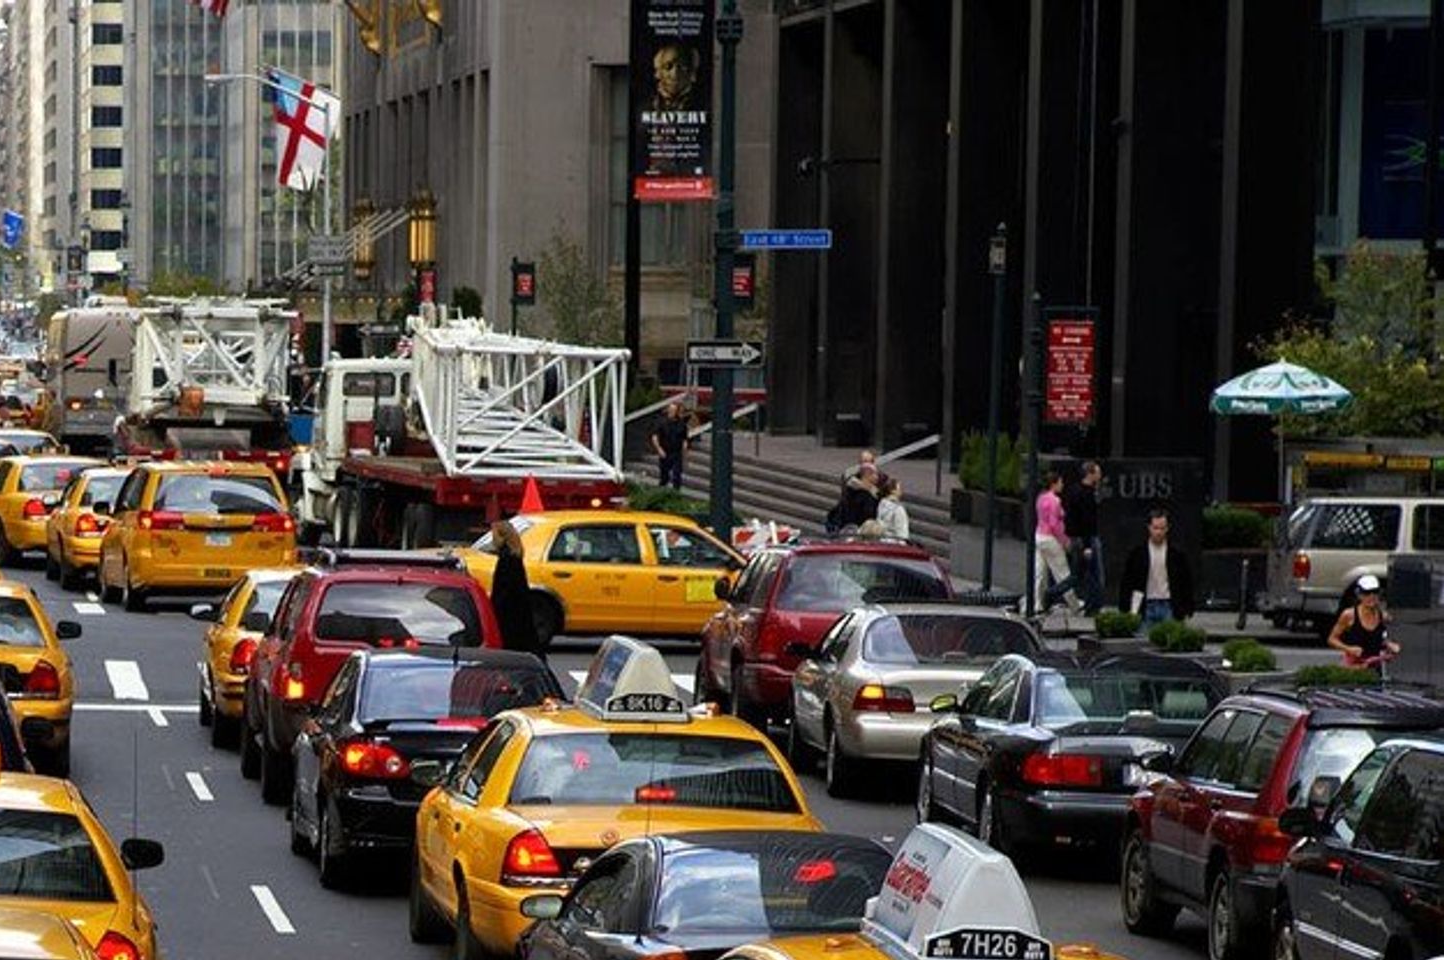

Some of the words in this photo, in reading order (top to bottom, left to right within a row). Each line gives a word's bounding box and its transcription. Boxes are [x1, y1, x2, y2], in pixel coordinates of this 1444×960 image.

[642, 111, 707, 123] SLAVERY
[793, 235, 826, 244] Street
[695, 348, 716, 358] ONE
[1119, 473, 1172, 498] UBS
[961, 933, 1017, 957] 7H26
